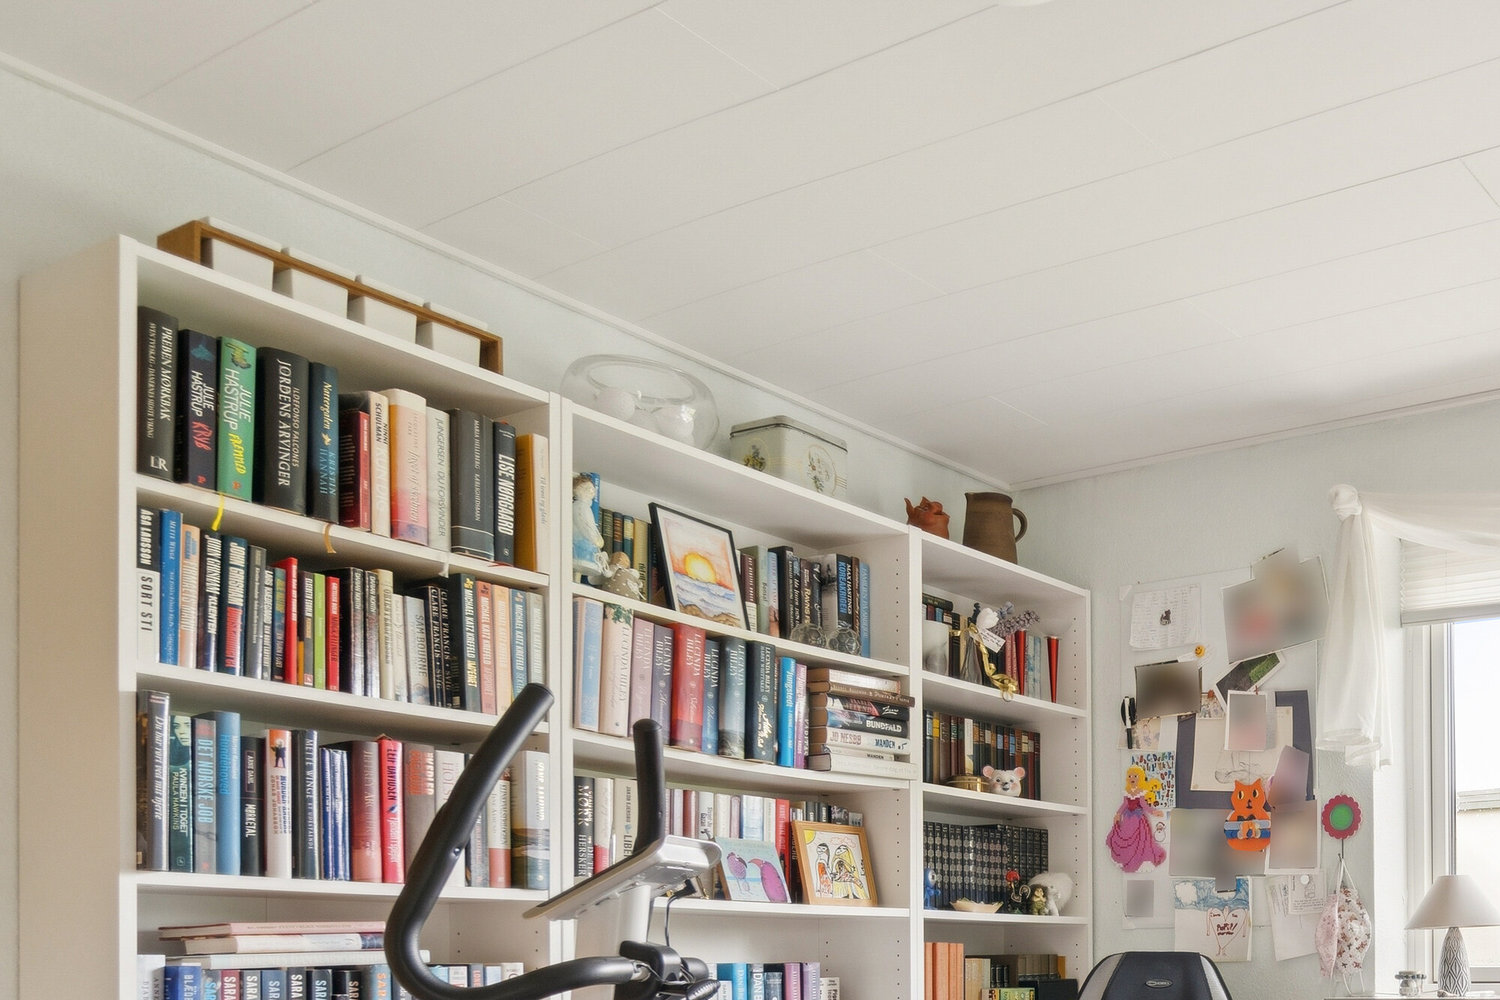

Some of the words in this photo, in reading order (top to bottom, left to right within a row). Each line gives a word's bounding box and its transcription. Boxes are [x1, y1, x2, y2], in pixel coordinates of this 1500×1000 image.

[160, 326, 173, 368] PREBEN
[159, 367, 172, 421] MØRKBAK
[191, 370, 203, 417] HASTRUP
[203, 383, 214, 410] JULIE
[223, 368, 239, 431] HASTRUP
[240, 385, 252, 423] JULIE
[277, 359, 292, 418] JORDENS
[292, 387, 301, 428] ILDEFONSO
[321, 382, 334, 430] Nattergalen
[227, 433, 247, 475] FREMMED
[277, 420, 291, 487] ARVINGER
[291, 430, 300, 467] FALCONES
[435, 418, 445, 466] JUNGERSEN
[320, 448, 328, 495] HANNAH
[328, 451, 337, 496] KRISTIN
[498, 454, 515, 480] LISE
[140, 509, 153, 526] ÅSA
[437, 486, 447, 537] FORSVINDER
[498, 480, 515, 536] NØRGAARD
[140, 527, 153, 565] LARSSON
[204, 535, 222, 557] JOHN
[229, 542, 246, 567] JOHN
[141, 575, 154, 607] SORT
[205, 558, 222, 595] GRISHAM
[228, 567, 244, 607] GRISHAM
[838, 561, 847, 614] KOREAKRIGEN
[207, 595, 218, 635] KLIENTEN
[431, 589, 440, 616] CLARE
[441, 591, 450, 619] CLARE
[464, 589, 475, 615] MICHAEL
[480, 596, 491, 622] MICHAEL
[515, 603, 525, 629] MICHAEL
[141, 612, 153, 631] STI
[415, 614, 425, 634] SAM
[465, 616, 474, 631] KATZ
[481, 623, 491, 639] KATZ
[515, 630, 525, 645] KATZ
[433, 620, 442, 658] FRANCIS
[443, 622, 451, 660] FRANCIS
[465, 632, 476, 658] KREFELD
[482, 639, 492, 665] KREFELD
[619, 626, 629, 671] LUCINDA
[643, 628, 651, 670] LUCINDA
[655, 640, 664, 668] RILEY
[686, 638, 694, 666] RILEY
[693, 633, 701, 677] LUCINDA
[417, 636, 427, 676] BOURNE
[515, 646, 525, 671] KREFELD
[663, 635, 671, 677] LUCINDA
[703, 653, 711, 680] RILEY
[711, 648, 719, 688] LUCINDA
[729, 650, 738, 677] RILEY
[737, 644, 745, 686] LUCINDA
[764, 647, 772, 674] LUCINDA
[619, 673, 628, 702] RILEY
[784, 671, 794, 707] Jungstedt
[865, 720, 902, 733] BUNDFALD
[197, 739, 213, 758] DET
[305, 739, 314, 767] METTE
[386, 748, 398, 765] LEIF
[179, 768, 188, 802] KVINDEN
[197, 761, 213, 800] NORSKE
[305, 769, 314, 799] WINGE
[387, 766, 399, 801] DAVIDSEN
[180, 809, 188, 836] TOGET
[198, 804, 213, 823] JOB
[245, 803, 256, 838] MØRKETAL
[578, 834, 587, 877] HERSKER
[224, 976, 236, 1000] SARA
[246, 975, 258, 999] SARA
[291, 975, 304, 998] SARA
[753, 973, 763, 993] DAN
